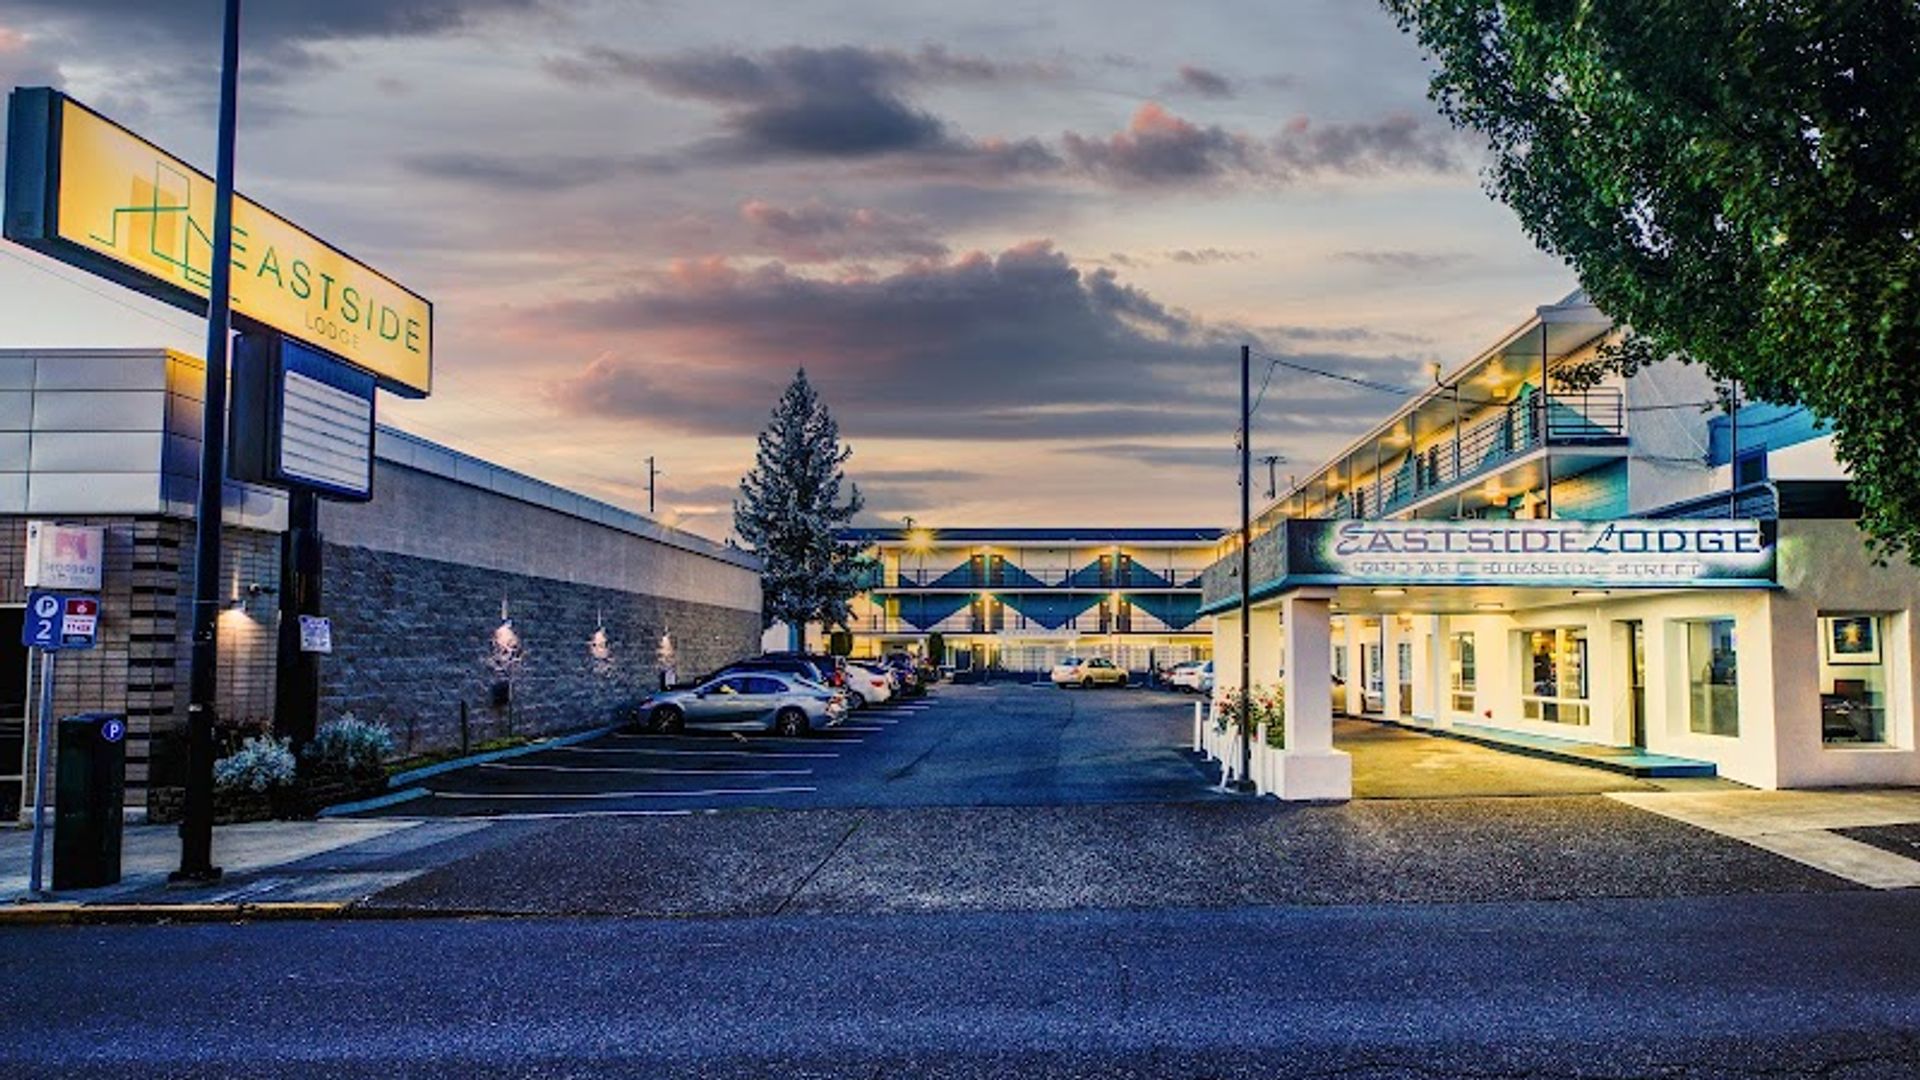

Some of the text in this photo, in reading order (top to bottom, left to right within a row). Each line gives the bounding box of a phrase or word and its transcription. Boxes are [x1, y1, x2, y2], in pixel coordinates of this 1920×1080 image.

[232, 226, 420, 353] EASTSIDE
[305, 311, 360, 349] LODGE
[1336, 523, 1760, 555] EASTSIDE LODGE
[1616, 563, 1700, 576] STREET
[36, 619, 52, 640] 2
[110, 723, 119, 738] P
